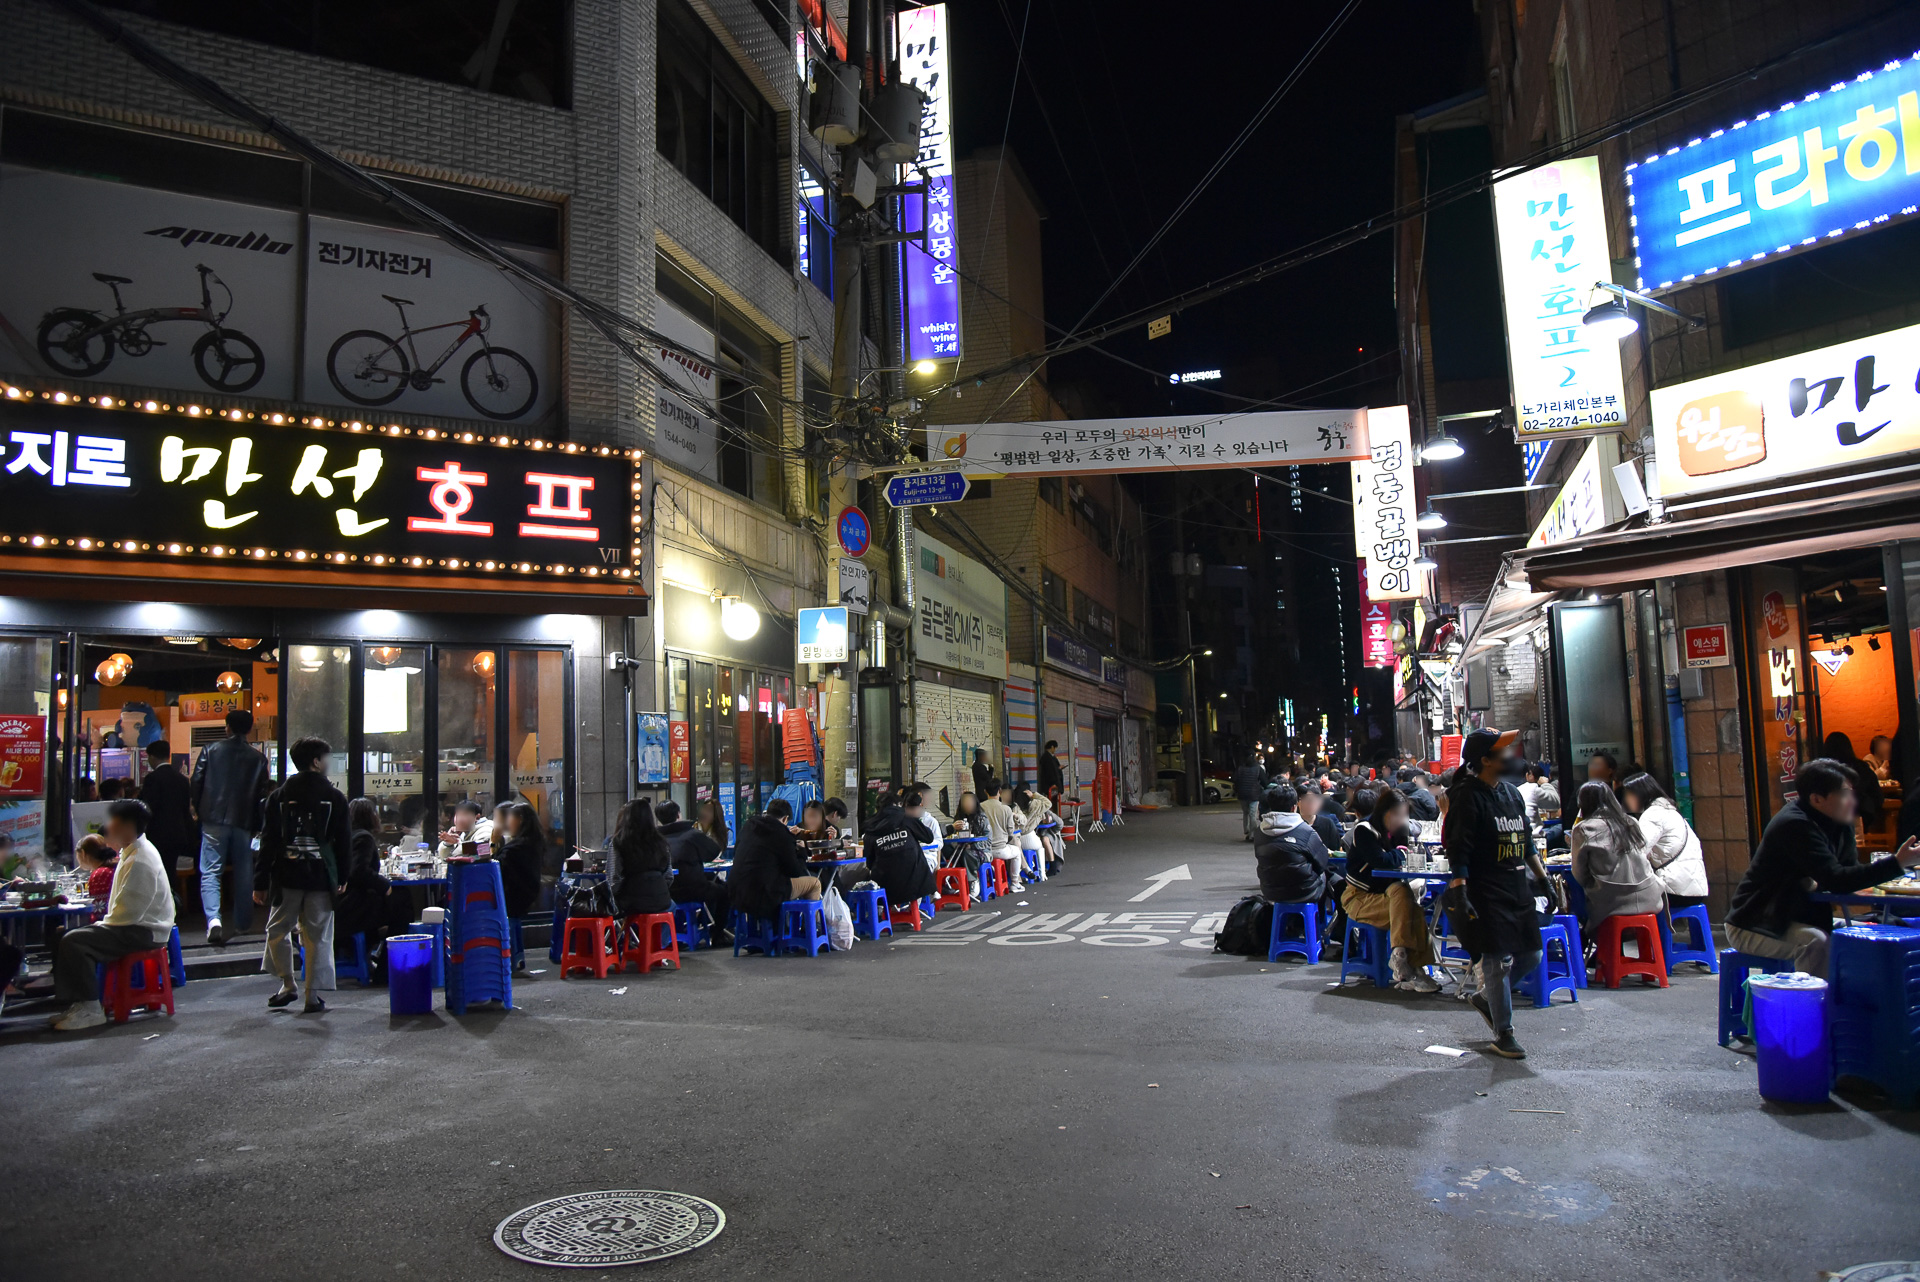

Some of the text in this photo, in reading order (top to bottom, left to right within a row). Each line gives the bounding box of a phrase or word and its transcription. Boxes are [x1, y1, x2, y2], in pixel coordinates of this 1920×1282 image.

[318, 241, 432, 279] 전기자전거
[920, 322, 957, 334] whisky
[930, 333, 957, 343] wine
[1522, 395, 1618, 416] 노가리체인본부
[659, 396, 700, 433] 전기자전거
[1523, 411, 1620, 431] 02-2274-1040
[663, 429, 697, 454] 1544-0403
[1040, 424, 1206, 445] 우리 모두의 안전의식만이
[0, 429, 132, 487] 지로
[1048, 448, 1081, 465] 일상,
[1088, 446, 1131, 462] 소중한
[1178, 443, 1206, 459] 지킬
[1212, 443, 1227, 457] 수
[1232, 439, 1289, 456] 있습니다
[902, 475, 946, 489] 을지로13길
[892, 488, 898, 496] 7
[903, 486, 947, 497] Eulji-ro 13-gil
[1370, 440, 1411, 592] 명동골뱅이
[842, 525, 867, 539] 주차금지
[920, 595, 985, 655] 골든벨CM(주)
[1693, 636, 1720, 649] 에스원
[1688, 659, 1710, 667] SECOM
[199, 698, 238, 713] 화장실
[371, 778, 413, 788] 만선호프
[516, 775, 554, 785] 만선호프
[876, 830, 908, 846] SAWO
[1497, 843, 1526, 862] DRAFT
[579, 1190, 662, 1203] GOVERNMENT
